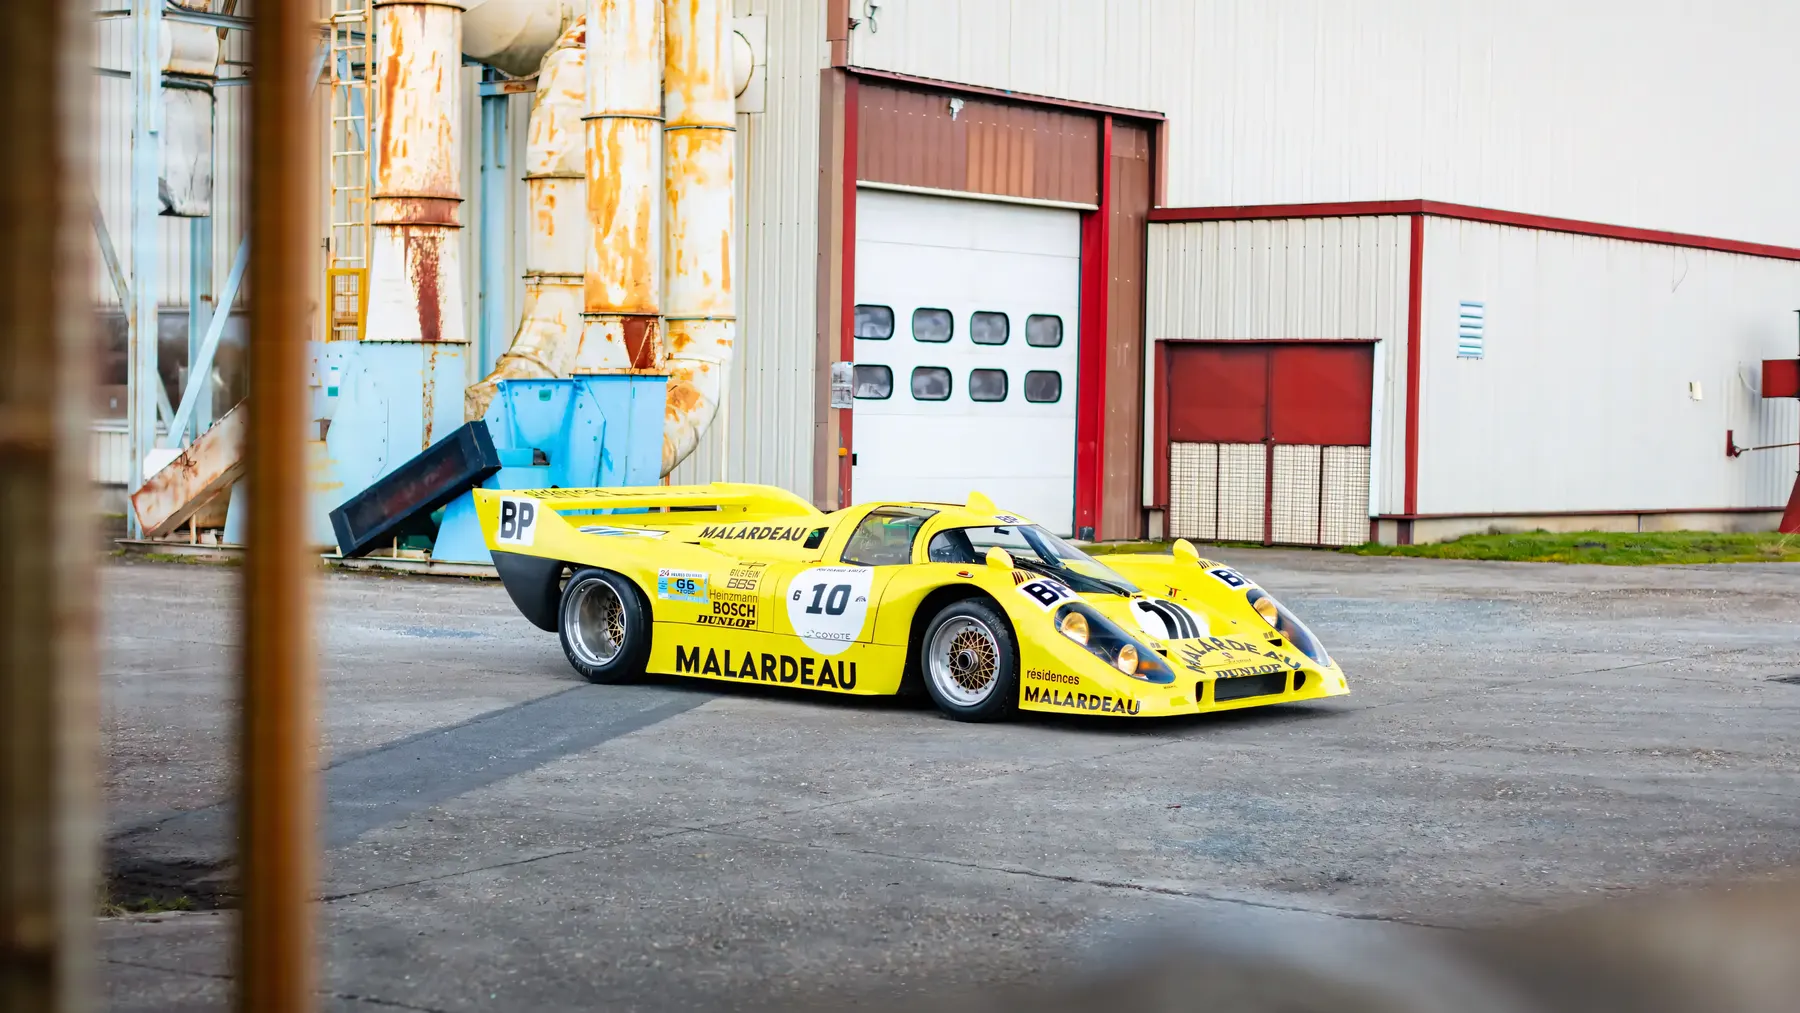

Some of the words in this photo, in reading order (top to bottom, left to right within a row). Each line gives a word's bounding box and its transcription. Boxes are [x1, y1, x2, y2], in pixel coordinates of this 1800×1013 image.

[500, 500, 535, 540] BP
[698, 526, 807, 542] MALARDEAU
[659, 569, 670, 577] 24
[729, 568, 760, 579] BILSTEIN
[1210, 569, 1253, 588] BP
[676, 578, 695, 590] G6
[726, 578, 757, 591] BBS
[709, 589, 758, 603] Heinzmann
[792, 589, 802, 601] 6
[805, 583, 852, 616] 10
[1022, 580, 1070, 607] BP
[713, 601, 756, 618] BOSCH
[696, 614, 756, 629] DUNLOP
[815, 631, 851, 640] COYOTE
[675, 645, 857, 691] MALARDEAU
[1026, 667, 1080, 685] résidences
[1214, 663, 1282, 679] DUNLOP
[1024, 685, 1141, 716] MALARDEAU
